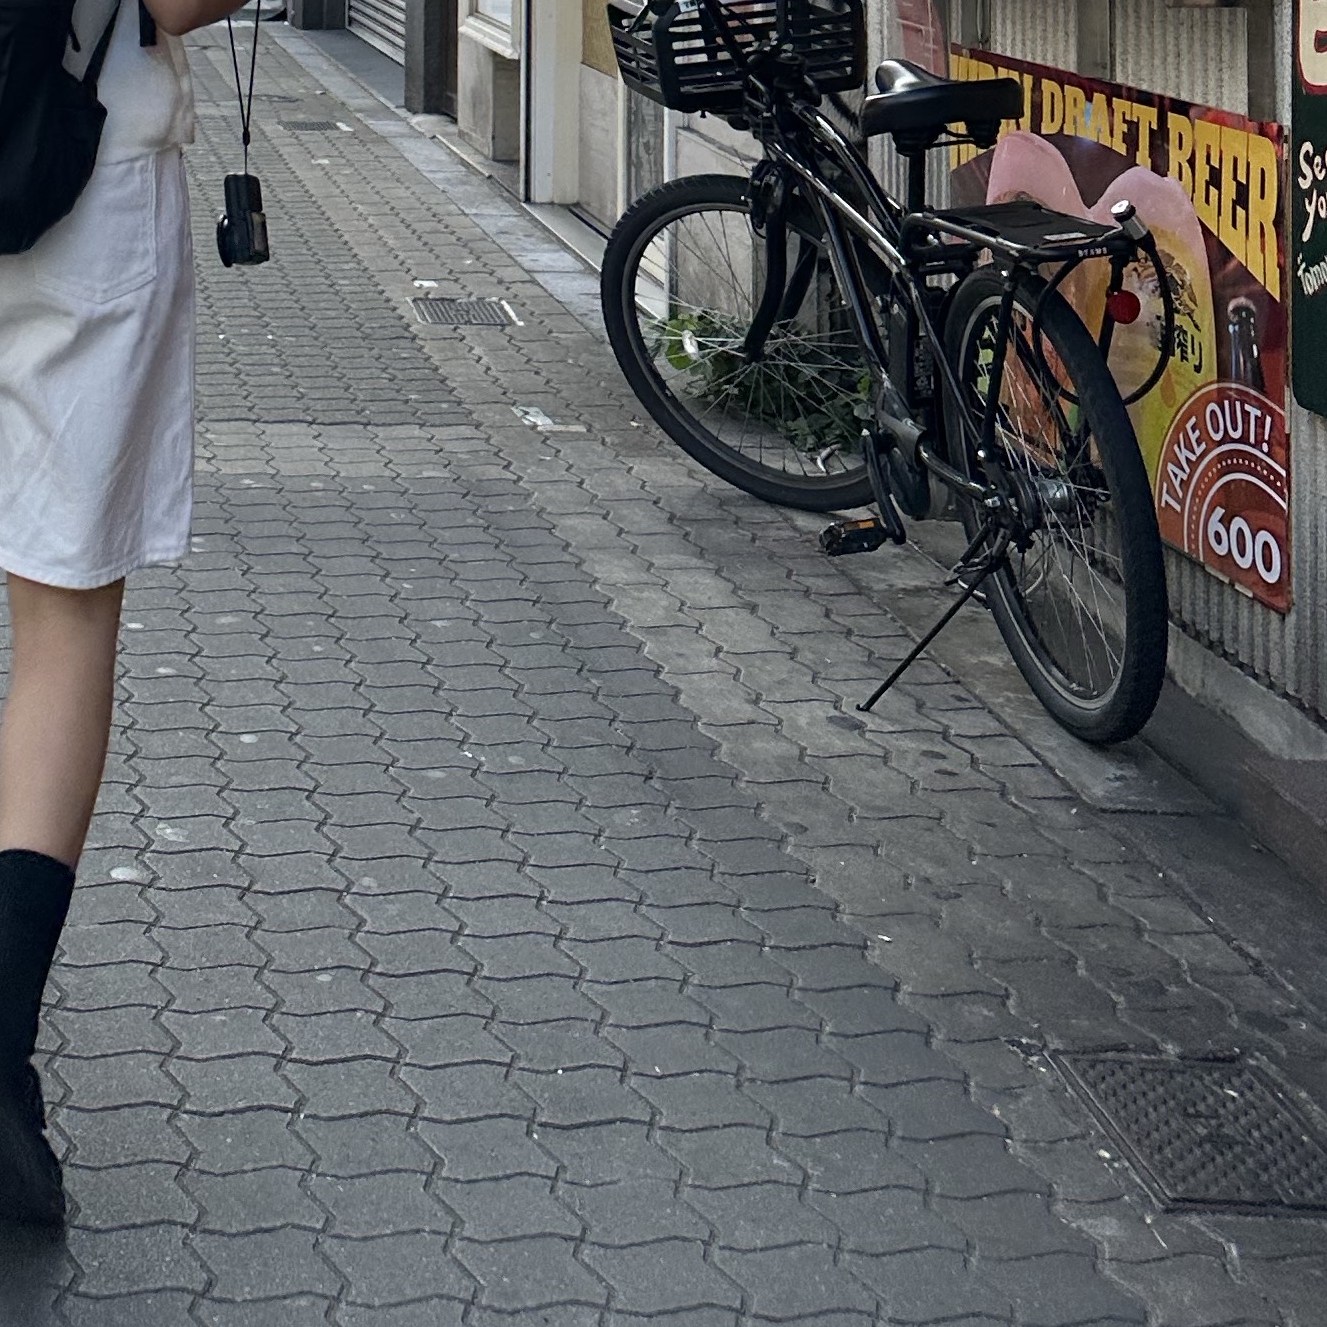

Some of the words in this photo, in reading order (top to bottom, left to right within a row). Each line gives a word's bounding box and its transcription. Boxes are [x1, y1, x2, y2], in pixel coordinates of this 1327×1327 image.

[1041, 78, 1157, 172] DRAFT
[1168, 111, 1281, 303] BEER
[1298, 141, 1327, 190] Se
[1302, 188, 1327, 242] yo
[1161, 415, 1207, 513] TAKE
[1205, 399, 1272, 453] OUT!
[1207, 505, 1281, 584] 600
